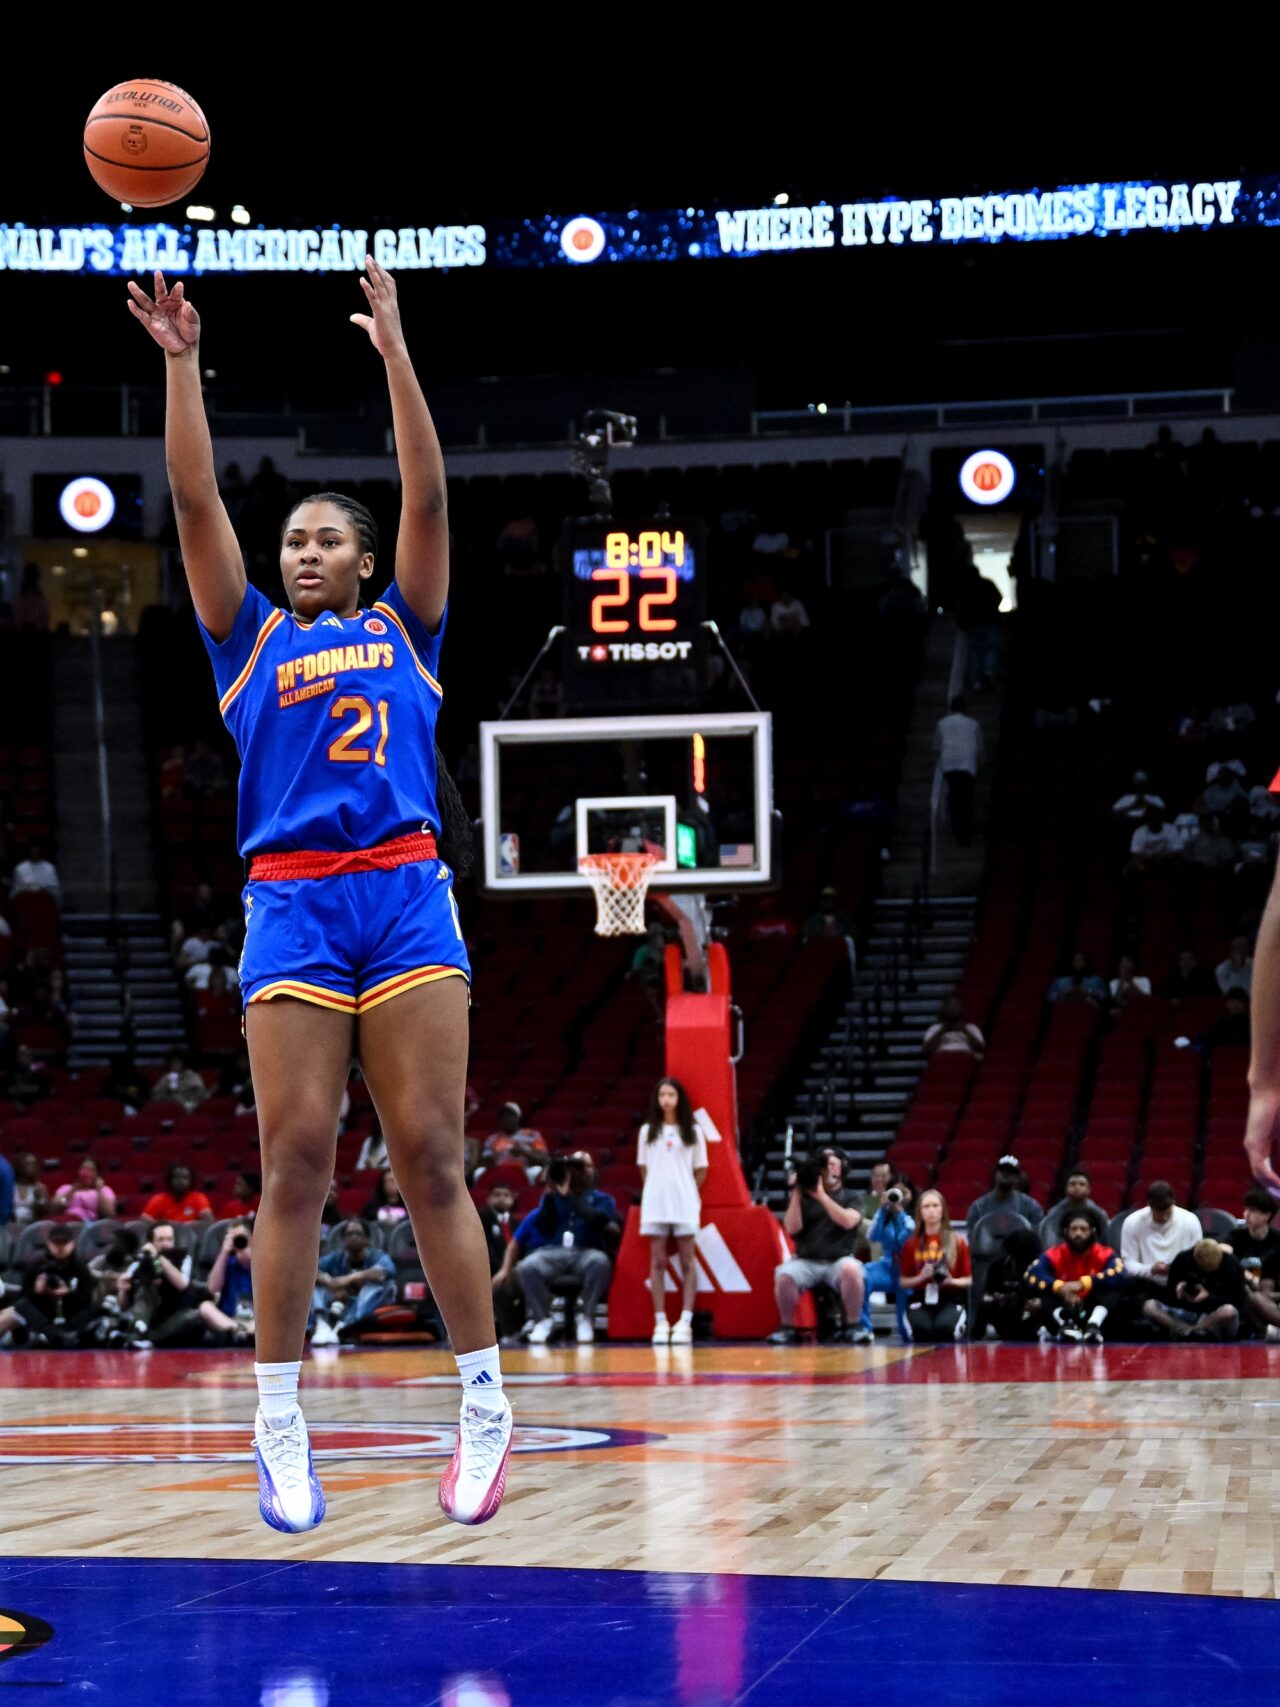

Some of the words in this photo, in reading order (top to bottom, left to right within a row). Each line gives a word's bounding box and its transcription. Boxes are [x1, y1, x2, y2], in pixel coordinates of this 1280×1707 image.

[105, 90, 184, 115] EVOLUTION
[715, 205, 835, 253] WHERE
[840, 200, 933, 246] HYPE
[939, 191, 1095, 240] BECOMES
[1102, 181, 1242, 230] LEGACY
[119, 228, 189, 271] ALL
[193, 229, 368, 271] AMERICAN
[374, 225, 487, 270] GAMES
[605, 530, 685, 569] 8:04
[591, 567, 678, 633] 22
[276, 642, 395, 693] McDONALD'S
[608, 641, 692, 662] TISSOT
[278, 692, 295, 709] ALL
[294, 677, 337, 704] AMERICAN
[327, 694, 389, 769] 21
